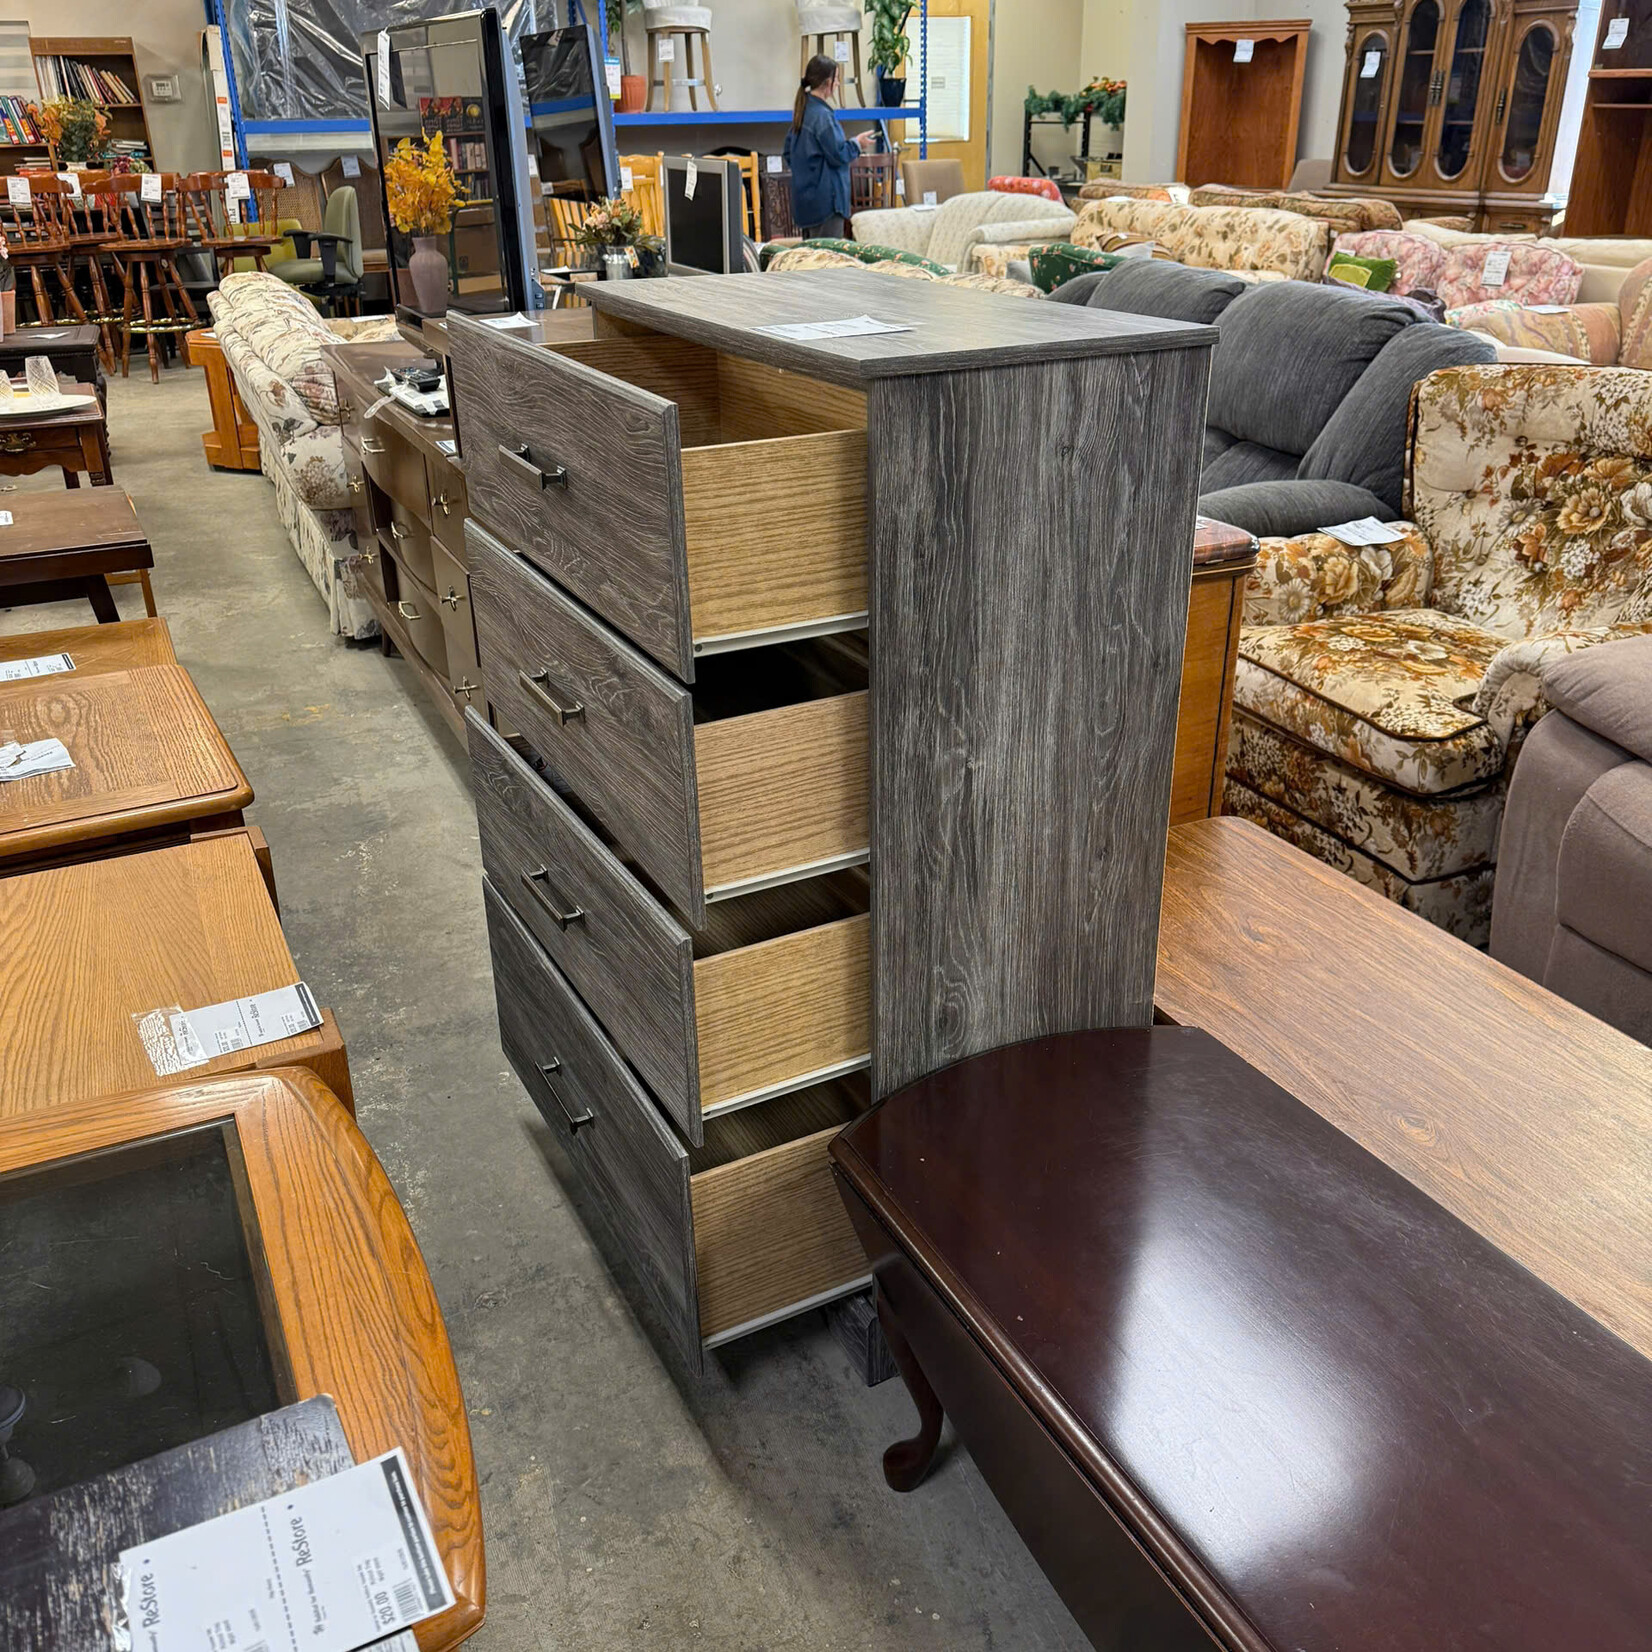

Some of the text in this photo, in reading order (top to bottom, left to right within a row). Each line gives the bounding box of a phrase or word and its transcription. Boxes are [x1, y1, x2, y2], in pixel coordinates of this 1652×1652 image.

[290, 1517, 313, 1567] ReStore
[139, 1573, 160, 1628] ReStore
[374, 1591, 395, 1625] $20.00
